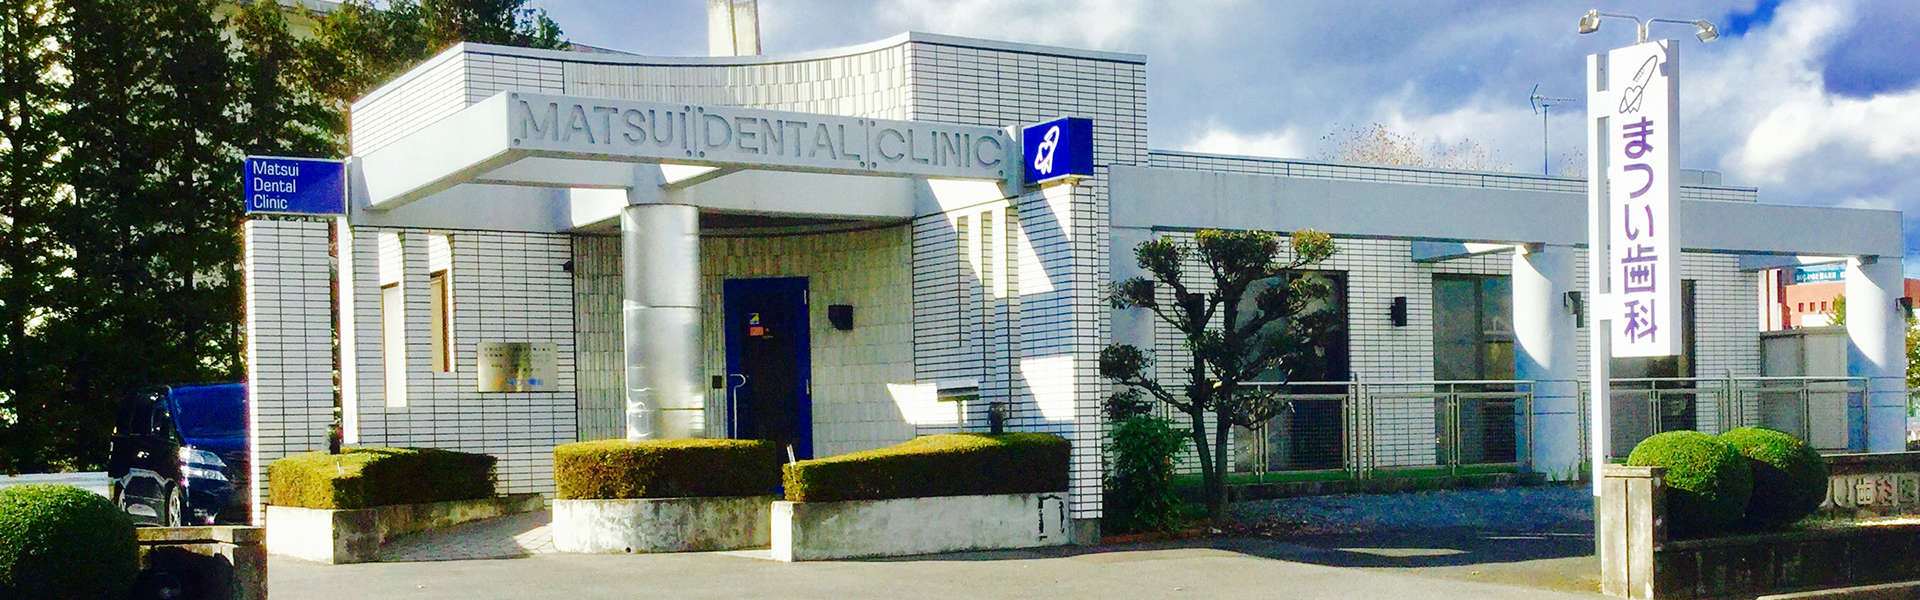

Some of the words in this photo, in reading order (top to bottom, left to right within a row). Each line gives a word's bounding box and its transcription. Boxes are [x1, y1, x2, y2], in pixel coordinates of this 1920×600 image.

[519, 100, 688, 150] MATSUI
[703, 113, 861, 161] DENTAL
[875, 128, 1002, 169] CLINIC
[253, 160, 299, 177] Matsui
[253, 177, 296, 193] Dental
[253, 194, 288, 209] Clinic
[1621, 116, 1658, 344] まつい歯科
